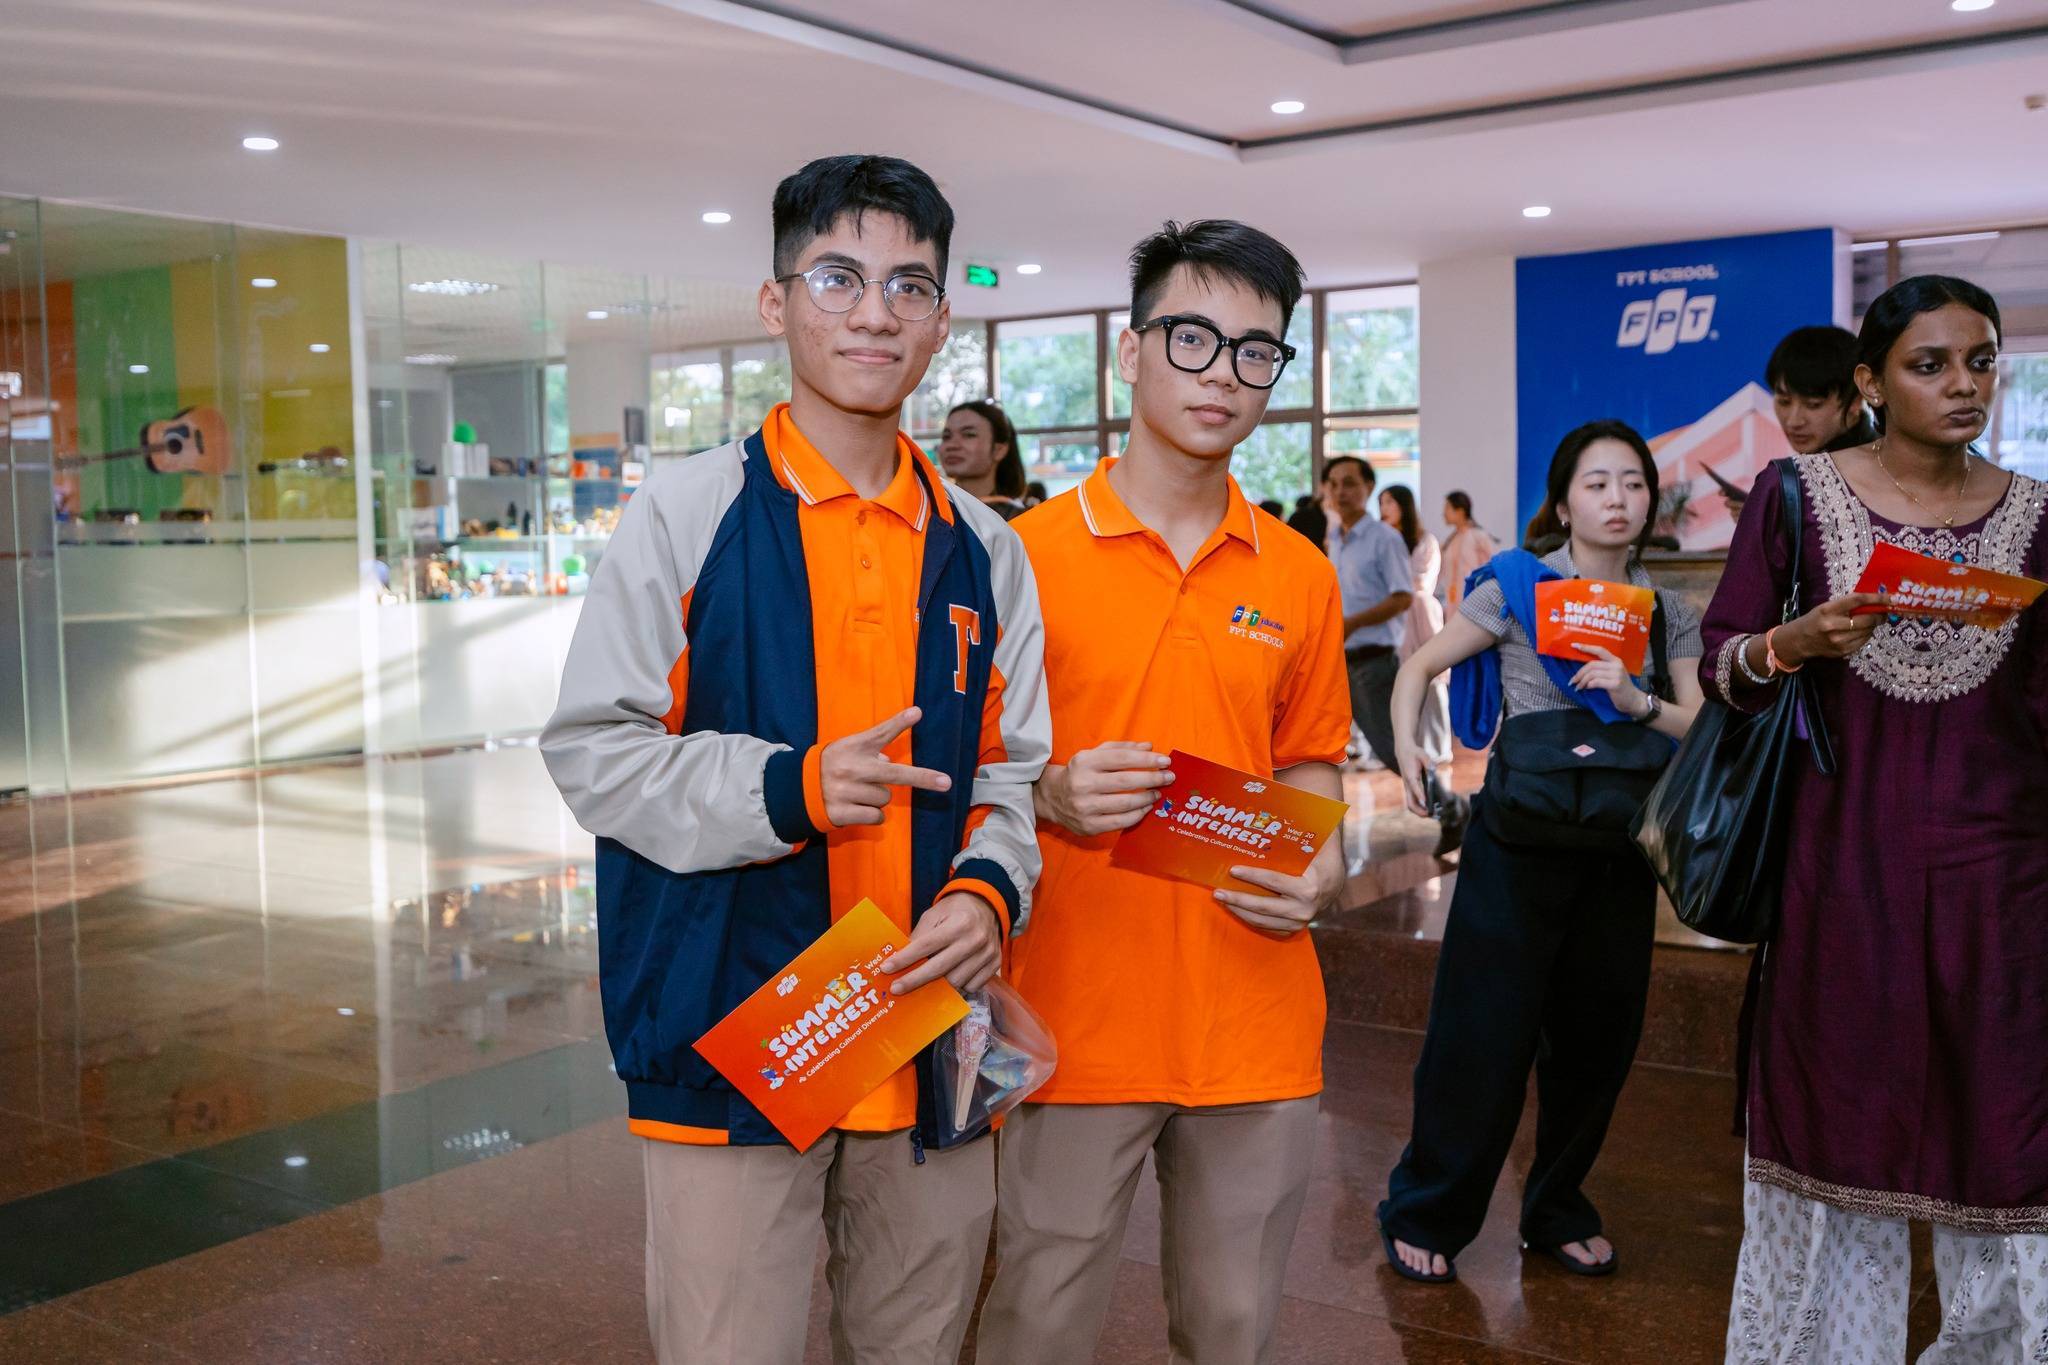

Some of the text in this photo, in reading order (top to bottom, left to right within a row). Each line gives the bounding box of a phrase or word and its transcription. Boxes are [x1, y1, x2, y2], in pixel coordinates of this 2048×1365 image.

[1649, 264, 1719, 284] SCHOOL
[1616, 287, 1717, 355] FPT
[1231, 604, 1261, 626] FPT
[1229, 625, 1247, 637] FPT
[1177, 811, 1271, 848] INTERFEST
[1177, 828, 1258, 858] Celebrating Cultural Diversity
[864, 944, 893, 970] Wed 20
[776, 973, 799, 997] FPT
[785, 988, 879, 1072] INTERFEST
[806, 1007, 889, 1077] Celebrating Cultural Diversity
